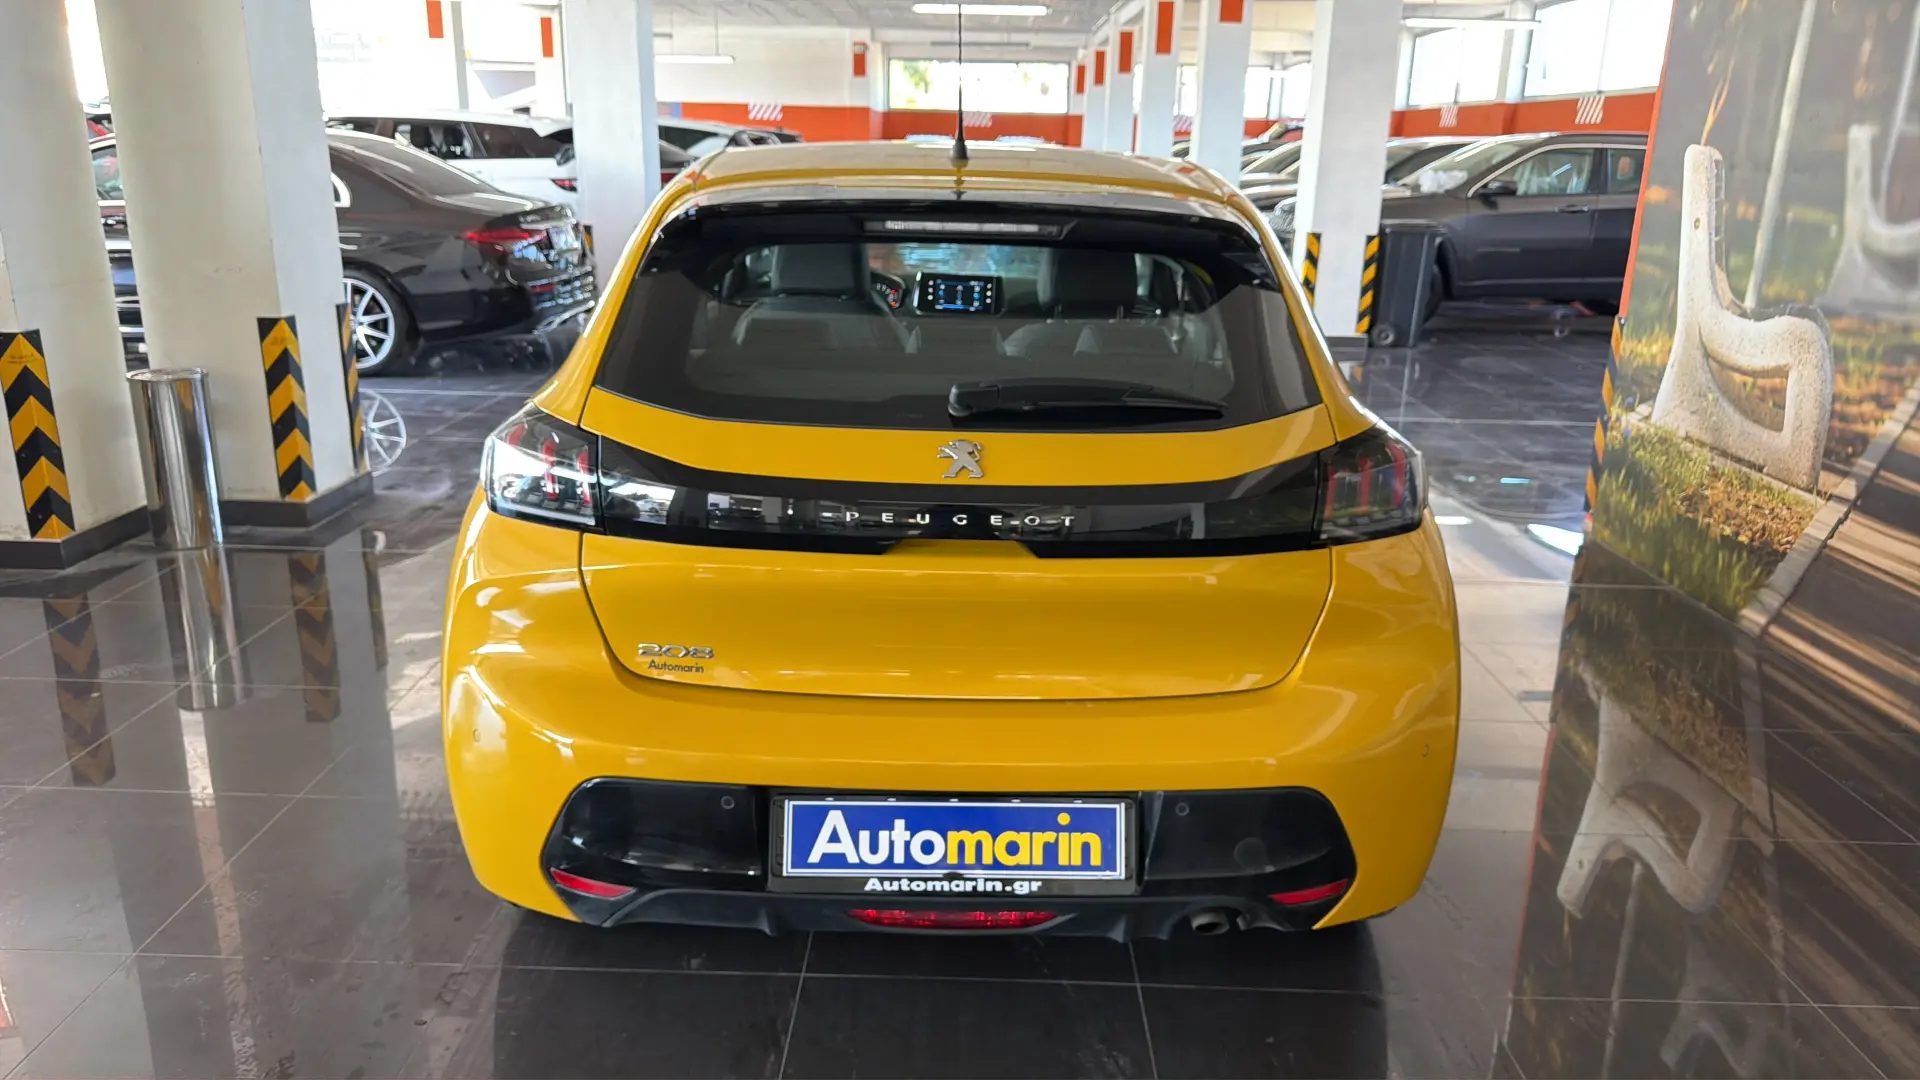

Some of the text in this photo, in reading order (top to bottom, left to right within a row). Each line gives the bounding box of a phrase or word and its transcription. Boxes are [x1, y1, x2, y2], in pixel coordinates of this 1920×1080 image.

[845, 511, 1075, 527] PEUGEOT
[638, 643, 715, 659] 208
[648, 659, 704, 673] Automarin
[807, 810, 1102, 866] Automarin
[864, 878, 1042, 895] Automarin.gr
